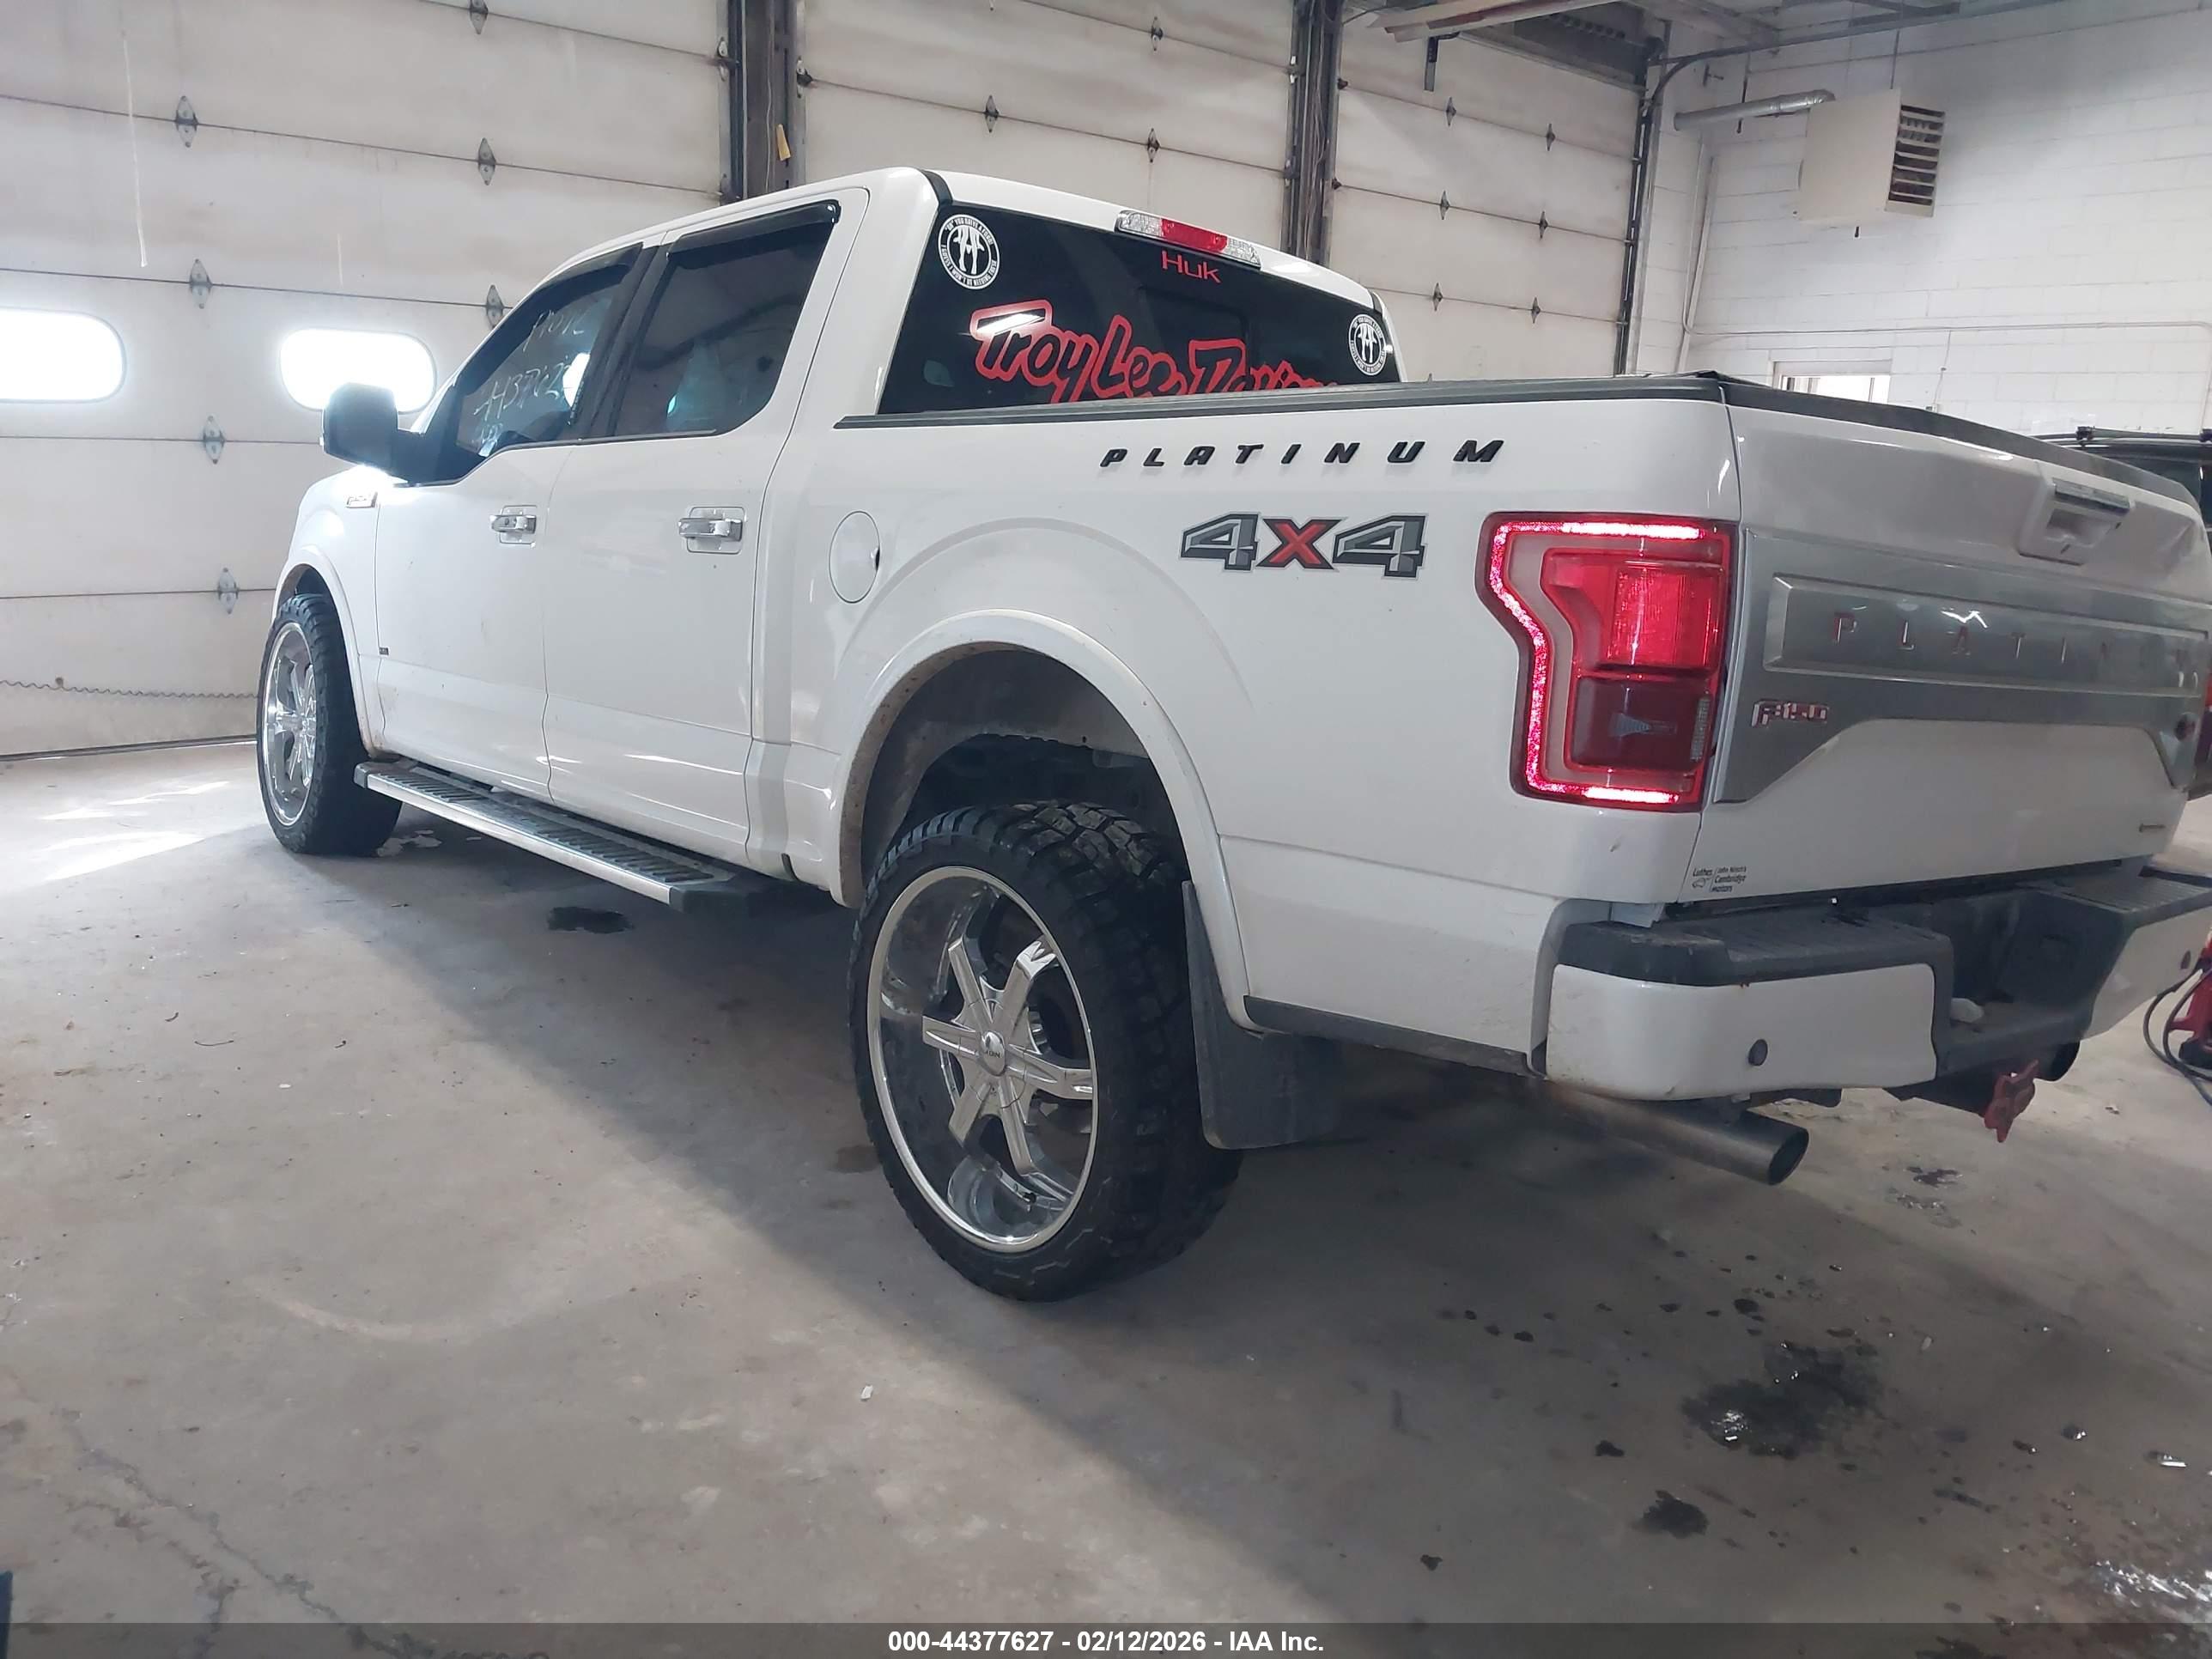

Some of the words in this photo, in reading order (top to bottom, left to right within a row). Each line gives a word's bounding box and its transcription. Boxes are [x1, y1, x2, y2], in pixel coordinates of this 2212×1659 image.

[1162, 250, 1221, 283] Huk
[969, 299, 1100, 404] Troy
[1100, 440, 1504, 467] PLATINUM
